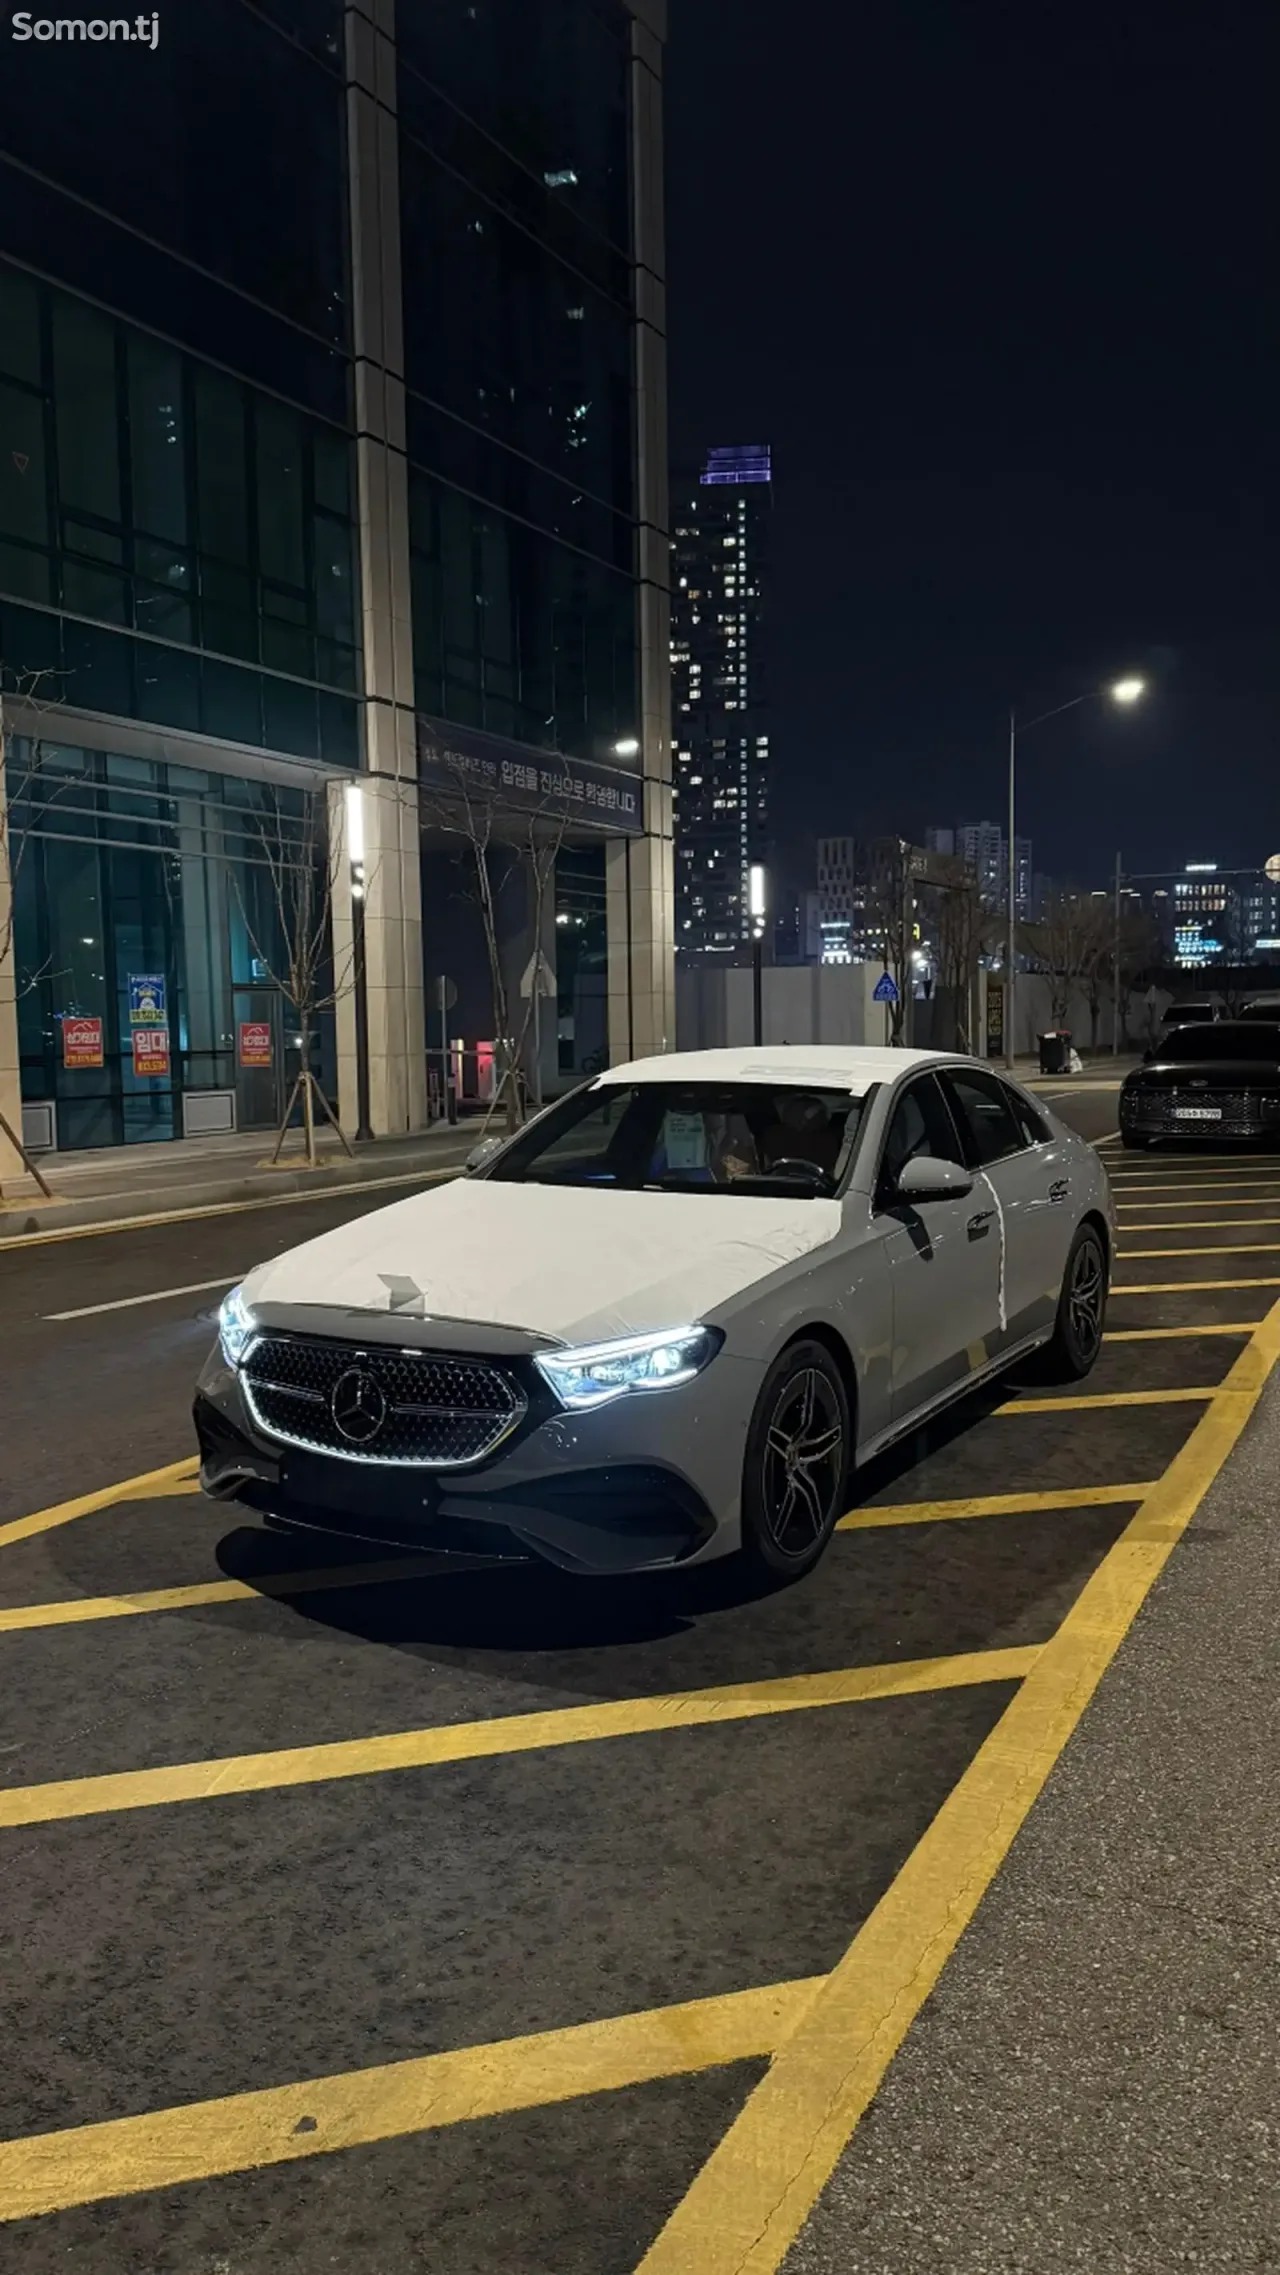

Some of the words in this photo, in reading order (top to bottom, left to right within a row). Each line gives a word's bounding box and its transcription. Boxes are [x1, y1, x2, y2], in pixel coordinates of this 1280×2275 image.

[501, 760, 538, 791] 입점을
[540, 770, 585, 801] 진심으로
[136, 1032, 166, 1053] 임대
